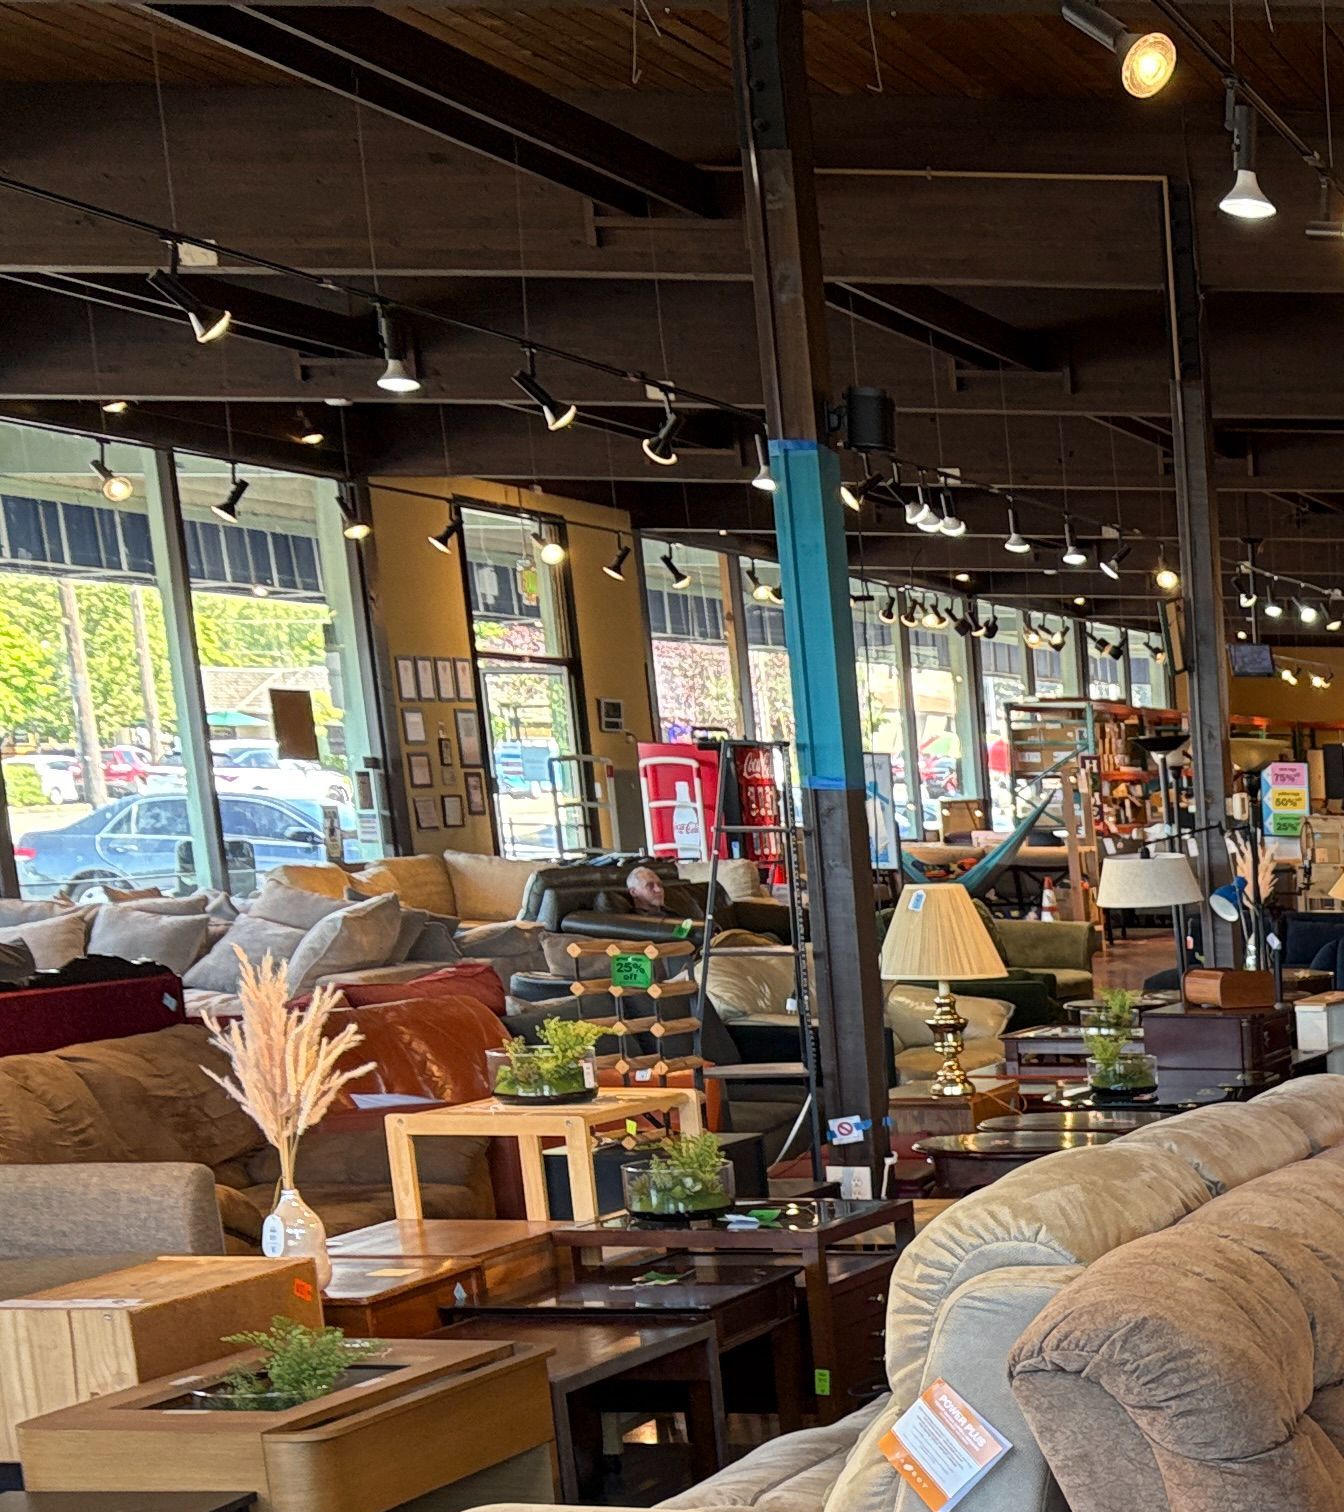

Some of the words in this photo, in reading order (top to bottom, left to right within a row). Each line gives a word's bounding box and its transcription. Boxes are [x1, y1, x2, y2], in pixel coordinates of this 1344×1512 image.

[616, 962, 646, 974] 25%
[623, 973, 637, 981] off
[938, 1394, 966, 1428] POWER
[963, 1421, 987, 1449] PLUS
